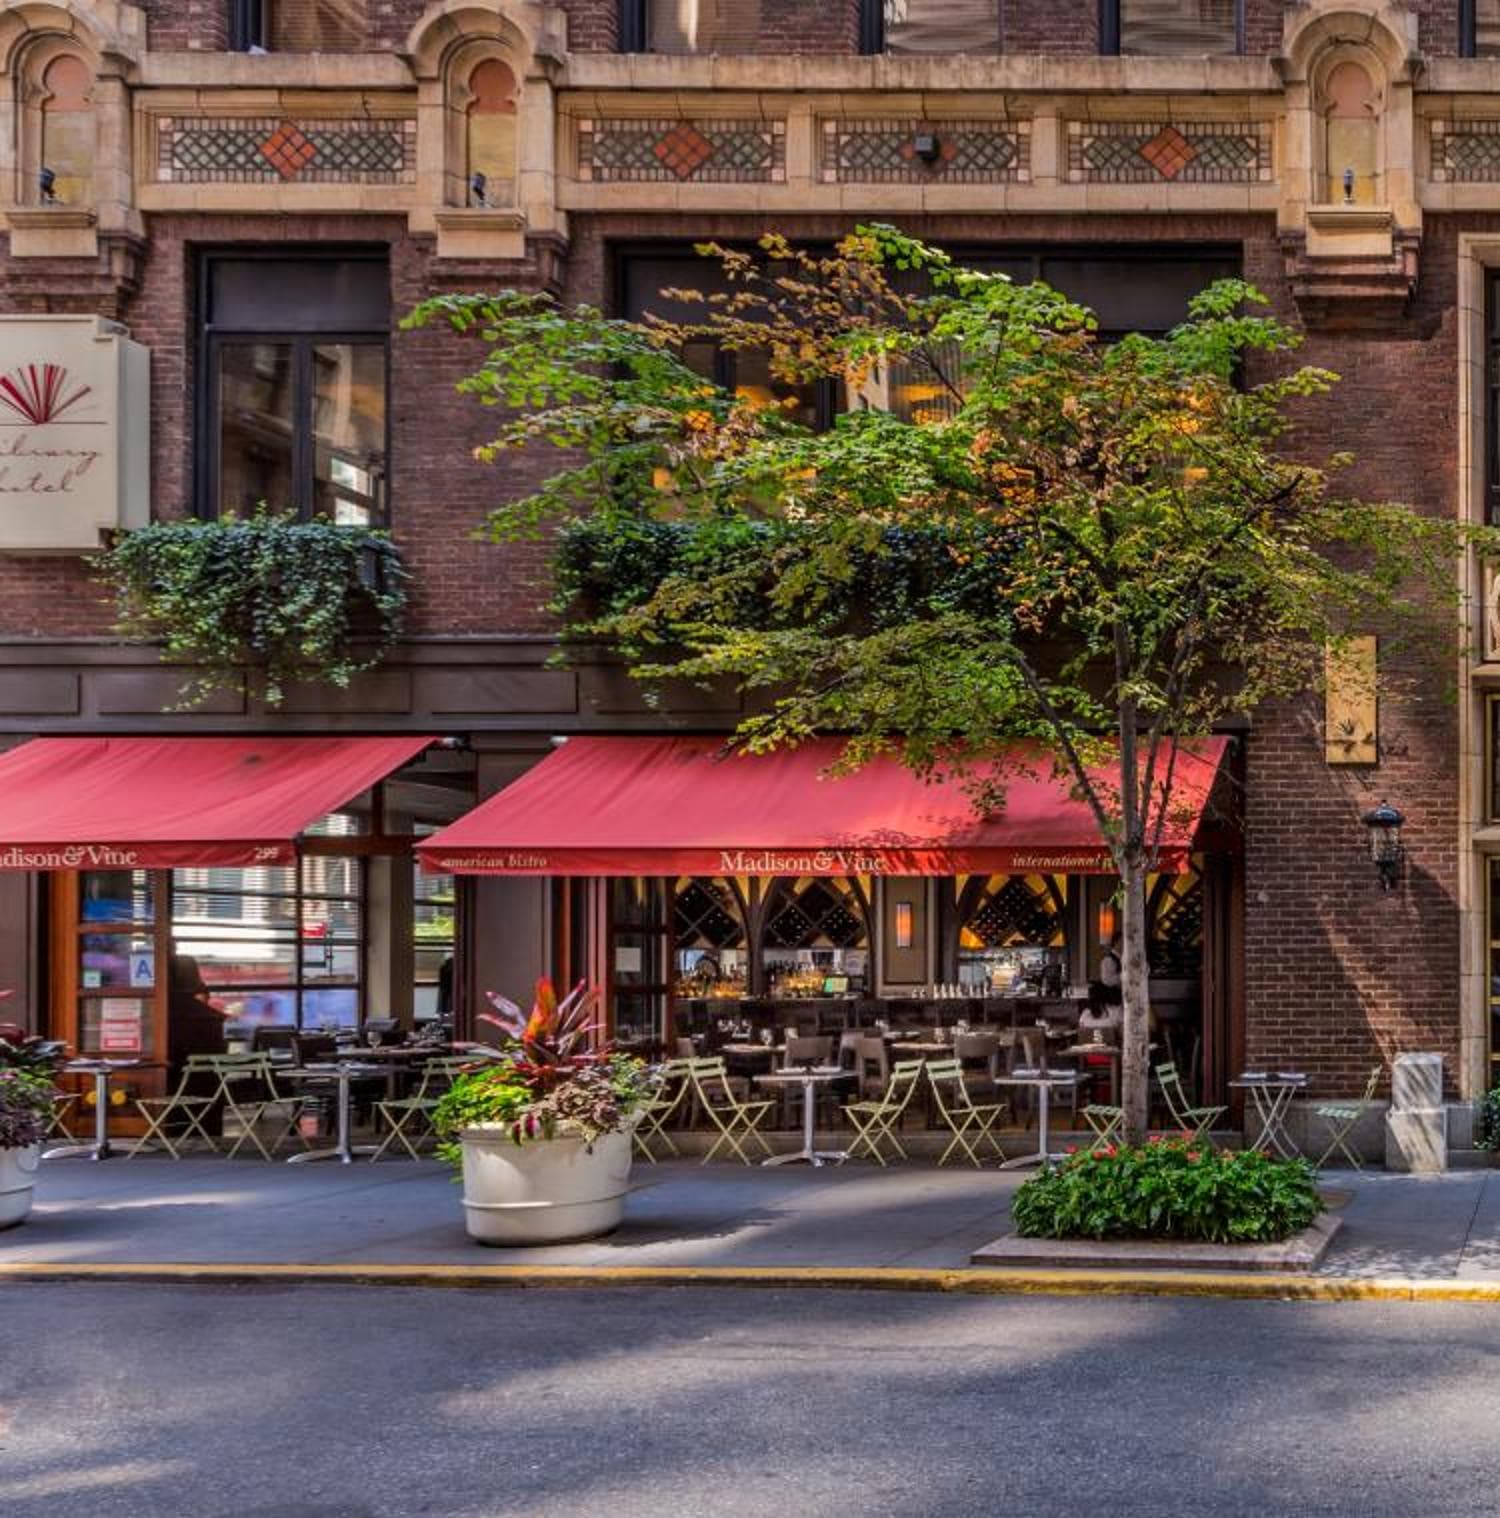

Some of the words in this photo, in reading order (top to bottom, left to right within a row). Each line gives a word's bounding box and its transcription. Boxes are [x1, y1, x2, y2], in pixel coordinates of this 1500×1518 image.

[0, 433, 103, 476] ibrary
[440, 853, 504, 868] american
[507, 852, 548, 868] bistro
[135, 959, 152, 978] A
